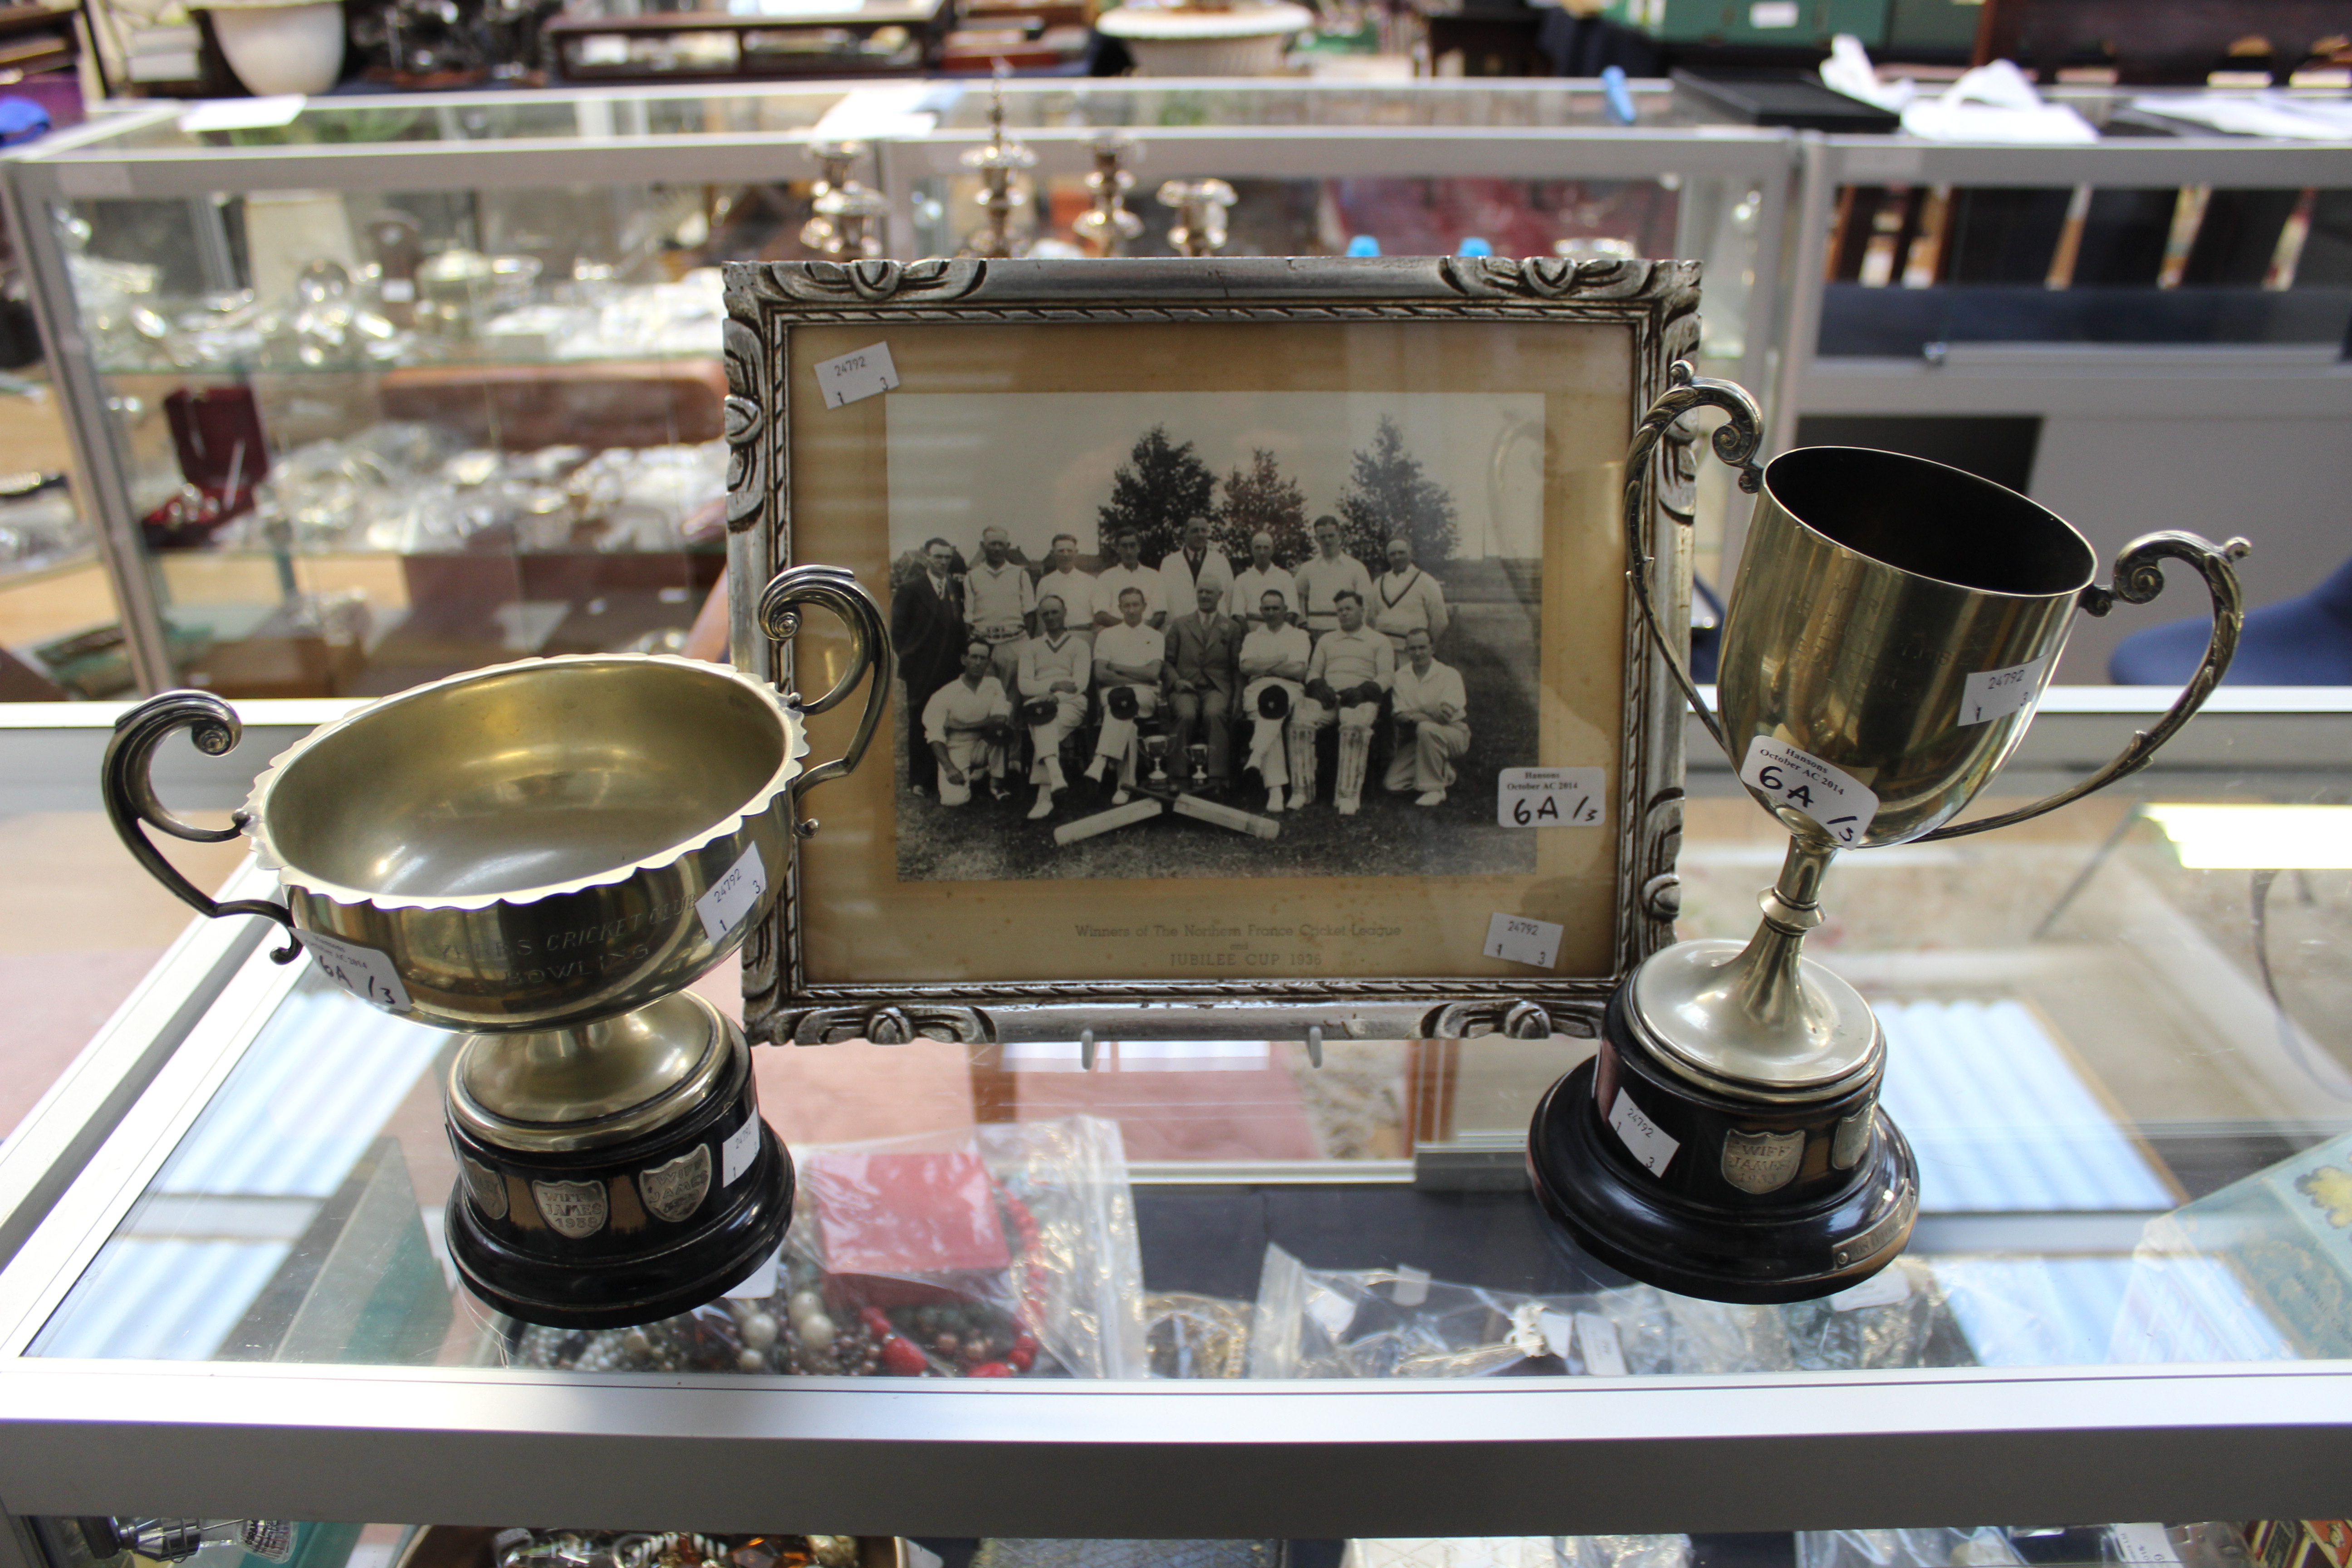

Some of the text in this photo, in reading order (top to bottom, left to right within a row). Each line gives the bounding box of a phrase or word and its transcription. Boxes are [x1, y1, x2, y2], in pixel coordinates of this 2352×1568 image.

[834, 356, 866, 376] 24792
[837, 376, 888, 405] 1 3
[1987, 669, 2025, 690] 24792
[1786, 748, 1828, 774] Hansons
[1760, 749, 1845, 796] October AC 2014
[714, 868, 742, 903] 24792
[753, 880, 760, 894] 3
[546, 913, 642, 951] CRICKET
[719, 919, 727, 932] 1
[1074, 923, 1402, 938] Winners of The Northern France Cricket League
[1508, 920, 1539, 936] 24792
[1170, 953, 1237, 966] JUBILEE
[1245, 953, 1280, 966] CUP
[1497, 943, 1546, 965] 1 3
[1627, 1108, 1654, 1138] 24792
[1646, 1156, 1655, 1168] 3
[543, 1192, 587, 1202] WIFF
[649, 1170, 709, 1204] JAMES
[545, 1203, 603, 1216] JAMES
